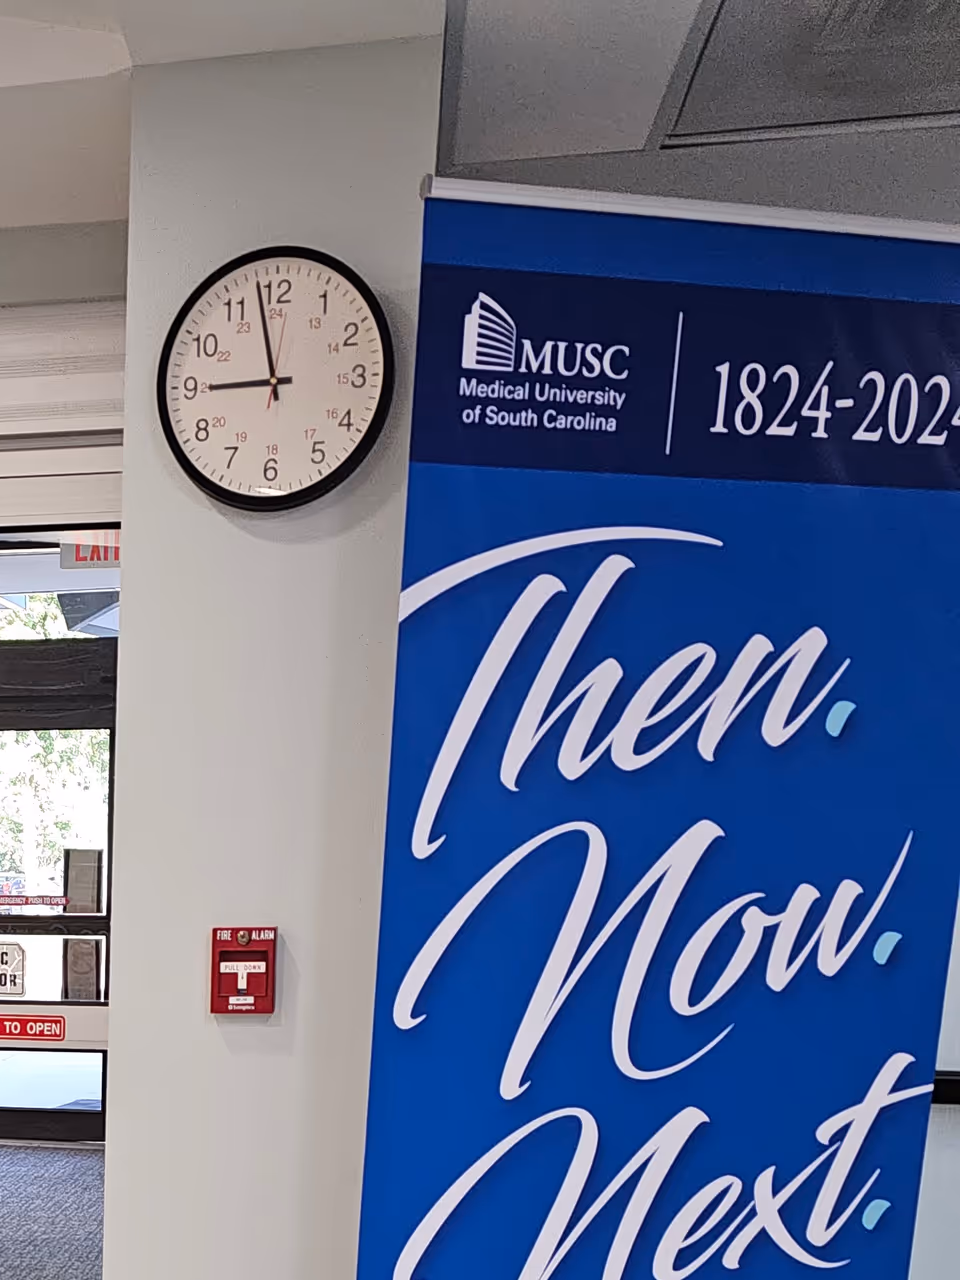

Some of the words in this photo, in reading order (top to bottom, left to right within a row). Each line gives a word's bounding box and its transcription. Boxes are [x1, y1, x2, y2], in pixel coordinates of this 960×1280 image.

[263, 279, 291, 305] 12
[319, 290, 328, 315] 1
[223, 297, 245, 322] 11
[269, 308, 283, 319] 24
[236, 322, 251, 334] 23
[309, 318, 321, 329] 13
[343, 322, 359, 347] 2
[192, 333, 218, 358] 10
[217, 351, 231, 362] 22
[328, 343, 339, 354] 14
[518, 339, 630, 380] MUSC
[337, 374, 348, 385] 15
[351, 364, 367, 388] 3
[183, 376, 198, 400] 9
[459, 377, 529, 400] Medical
[535, 383, 626, 410] University
[212, 417, 226, 427] 20
[326, 408, 338, 419] 16
[338, 408, 354, 432] 4
[462, 405, 482, 423] of
[485, 405, 538, 427] South
[543, 409, 617, 432] Carolina
[195, 418, 209, 442] 8
[235, 432, 247, 442] 19
[304, 429, 316, 440] 17
[224, 446, 239, 469] 7
[266, 445, 278, 455] 18
[310, 441, 326, 464] 5
[263, 458, 278, 481] 6
[399, 527, 857, 859] Then.
[217, 930, 232, 940] FIRE
[251, 930, 275, 940] ALARM
[392, 820, 913, 1100] Now.
[4, 1021, 20, 1034] TO
[26, 1022, 60, 1035] OPEN
